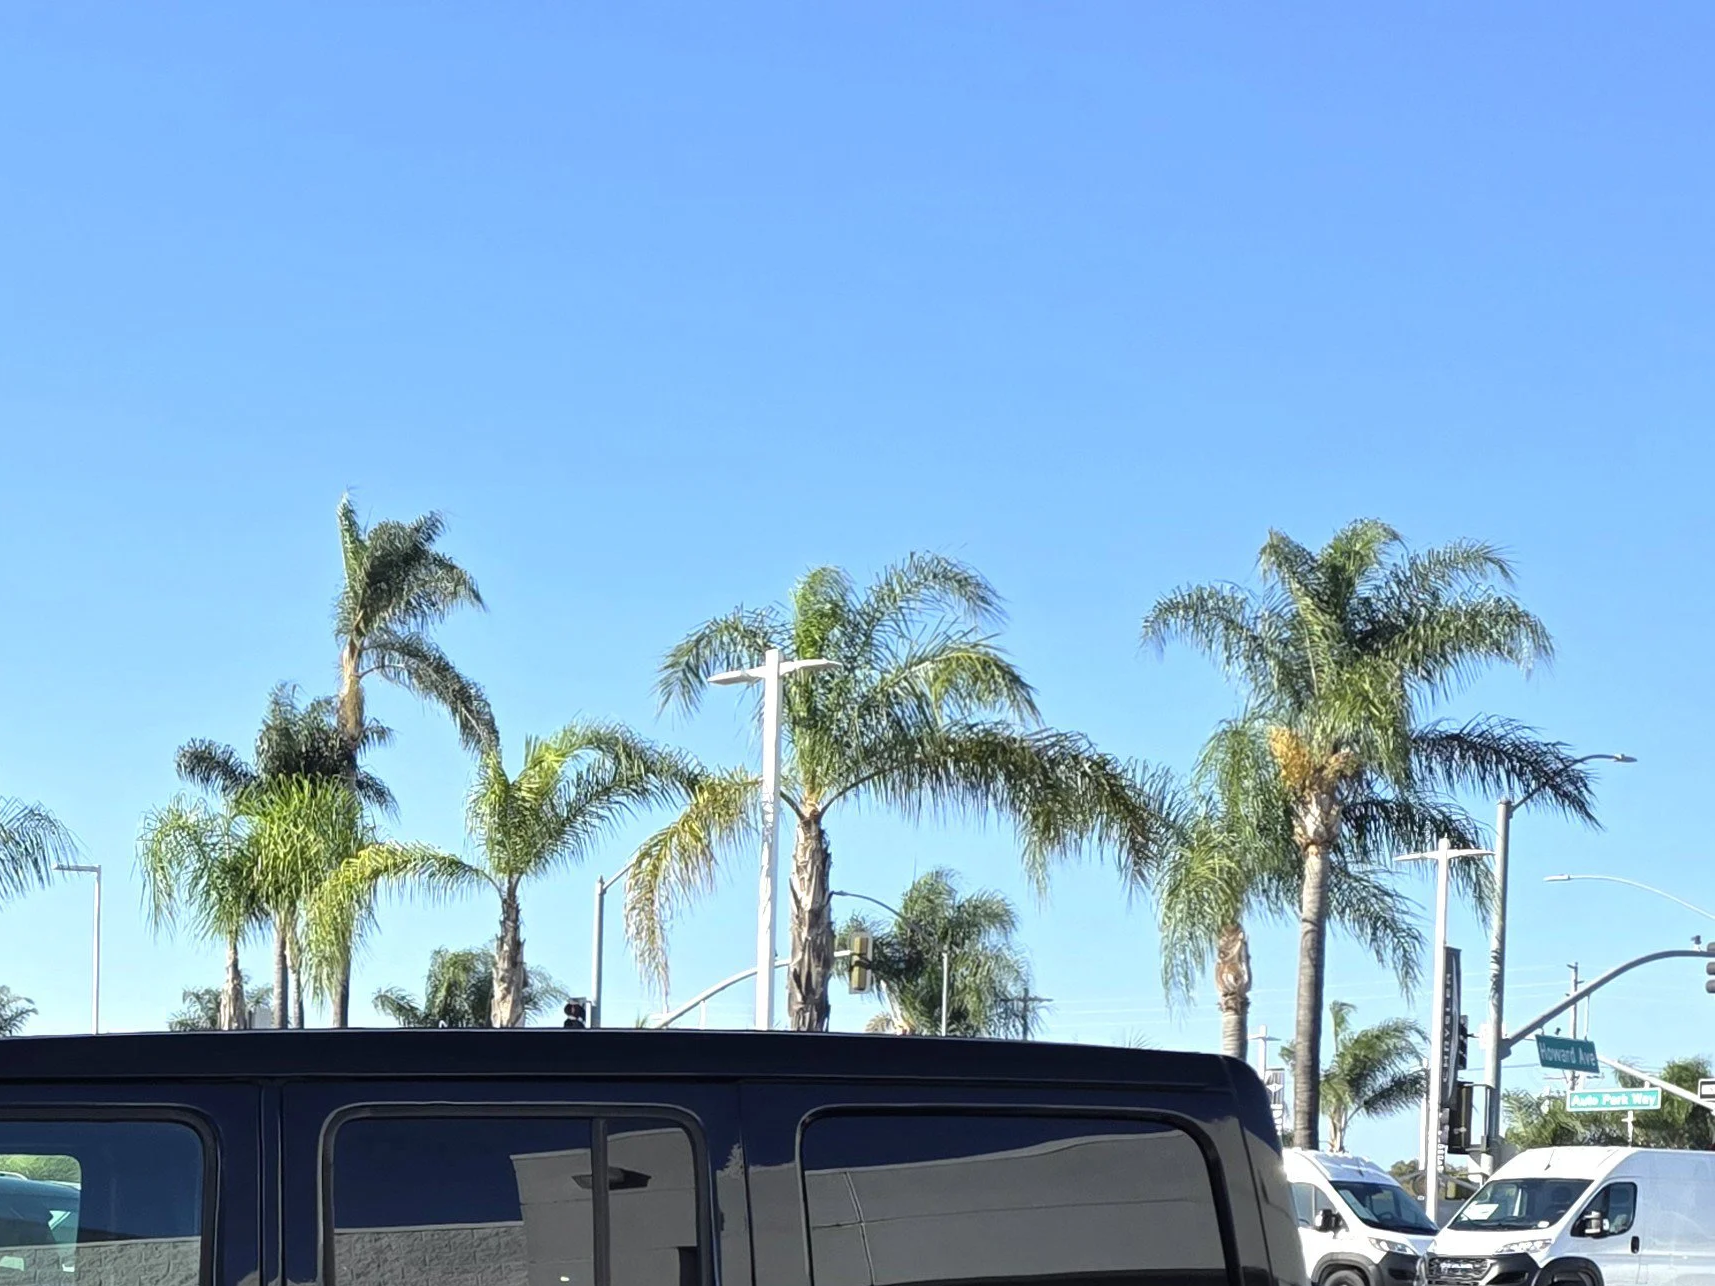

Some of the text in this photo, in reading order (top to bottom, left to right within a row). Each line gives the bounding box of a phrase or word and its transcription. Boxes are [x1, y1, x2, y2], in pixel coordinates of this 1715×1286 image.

[1539, 1042, 1597, 1067] Howard Ave
[1571, 1091, 1657, 1107] Auto Park Way
